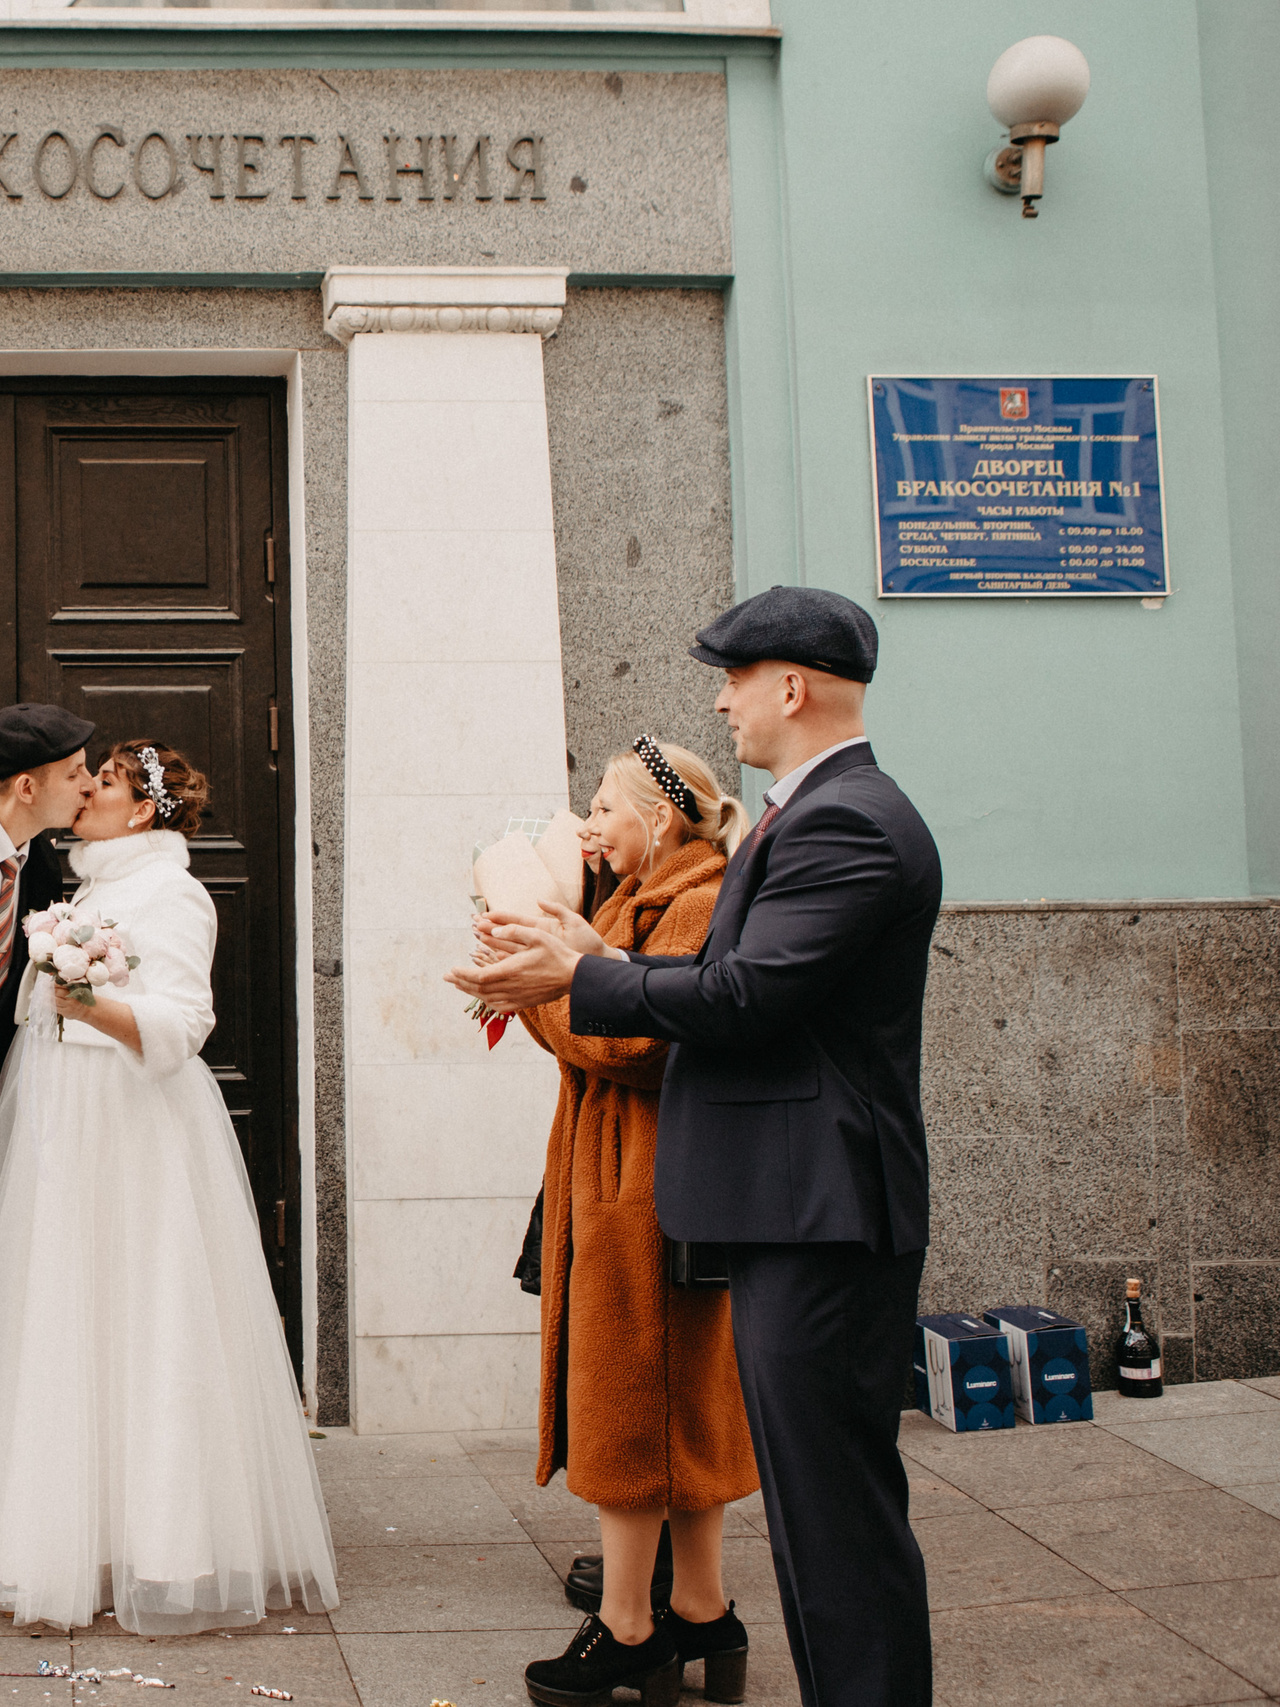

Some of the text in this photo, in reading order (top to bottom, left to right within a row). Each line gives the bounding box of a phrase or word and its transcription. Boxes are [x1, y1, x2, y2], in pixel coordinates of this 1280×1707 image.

[959, 424, 1073, 434] Правительство Москвы
[980, 442, 1055, 452] города Москвы
[972, 459, 1065, 479] ДВОРЕЦ
[896, 480, 1141, 497] БРАКОСОЧЕТАНИЯ №1
[977, 506, 1064, 516] ЧАСЫ РАБОТЫ
[898, 521, 1035, 531] ПОНЕДЕЛЬНИК, ВТОРНИК,
[898, 531, 1042, 541] СРЕДА, ЧЕТВЕРГ, ПЯТНИЦА
[1058, 528, 1066, 536] с
[1098, 528, 1112, 537] до
[1115, 526, 1143, 536] 18.00
[899, 545, 948, 554] СУББОТА
[1059, 546, 1067, 554] с
[1099, 546, 1113, 555] до
[1115, 545, 1145, 554] 24.00
[900, 558, 977, 567] ВОСКРЕСЕНЬЕ
[1060, 559, 1068, 567] с
[1100, 559, 1114, 568] до
[1117, 558, 1146, 567] 18.00
[949, 571, 1098, 580] ПЕРВЫЙ ВТОРНИК КАЖДОГО МЕСЯЦА
[977, 581, 1071, 591] САНИТАРНЫЙ ДЕНЬ
[1044, 1371, 1075, 1382] Luminarc
[966, 1379, 998, 1390] Luminarc
